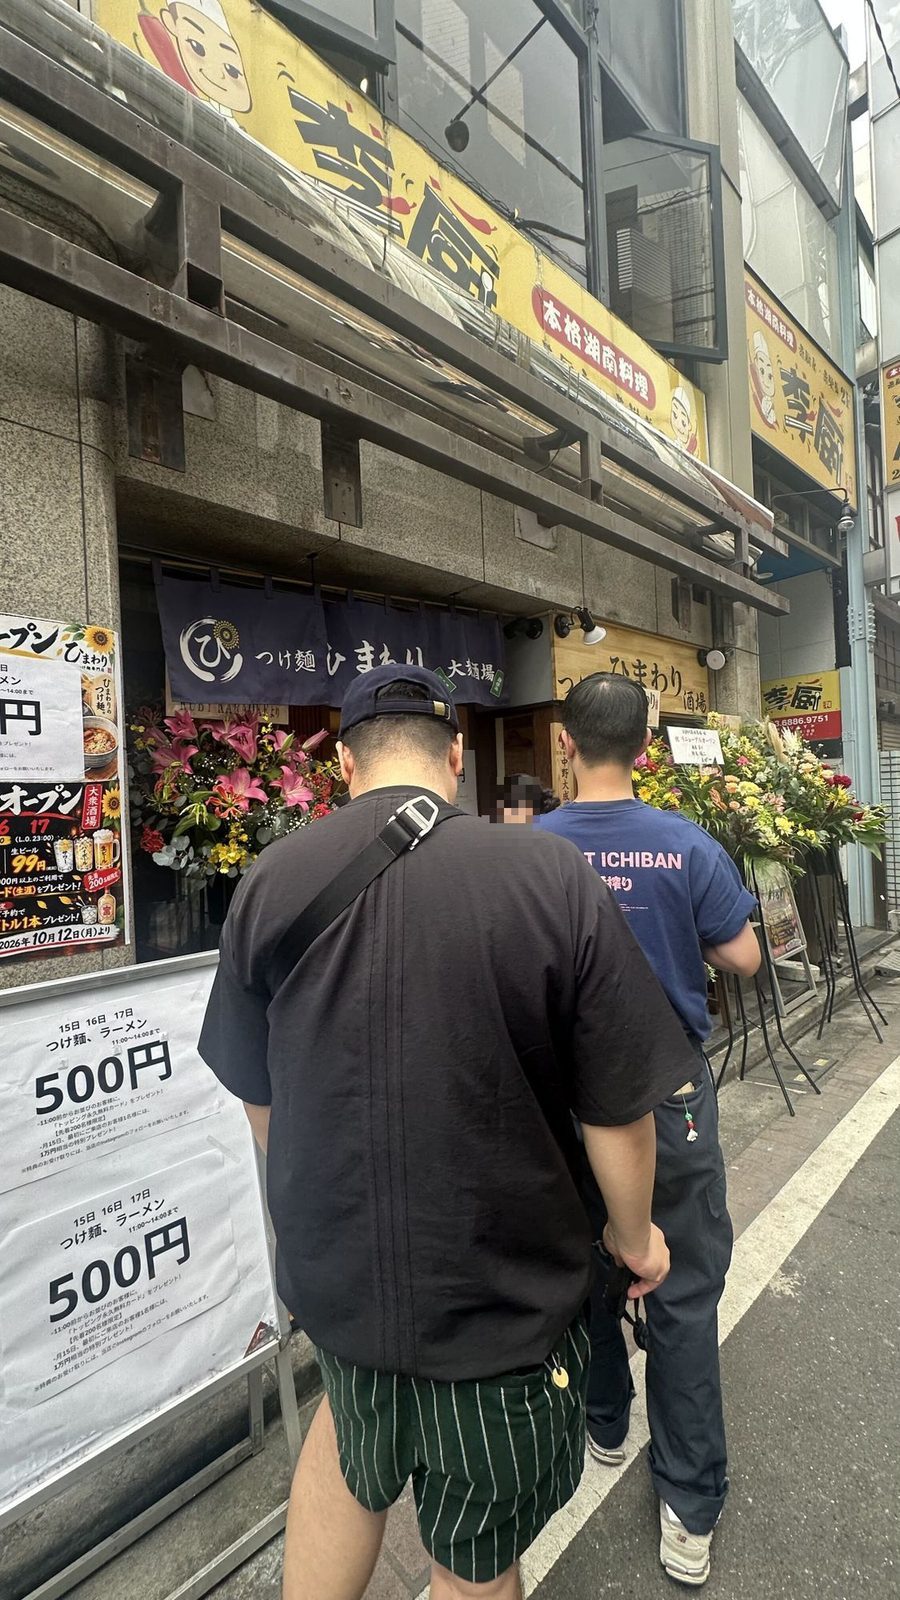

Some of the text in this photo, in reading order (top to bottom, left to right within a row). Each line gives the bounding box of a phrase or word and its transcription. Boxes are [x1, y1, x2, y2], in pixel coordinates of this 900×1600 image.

[64, 641, 108, 668] ひまわり
[683, 691, 707, 713] 酒場
[0, 698, 42, 737] 円
[0, 784, 83, 816] オープン
[85, 786, 100, 828] 大衆酒場
[31, 819, 50, 834] 17
[11, 847, 40, 856] 生ビール
[12, 854, 47, 874] 99円
[601, 851, 682, 870] ICHIBAN
[59, 1007, 134, 1033] 15日 16日 17日
[35, 1040, 173, 1115] 500円
[73, 1188, 151, 1228] 15日 16日 17日
[49, 1216, 191, 1323] 500円
